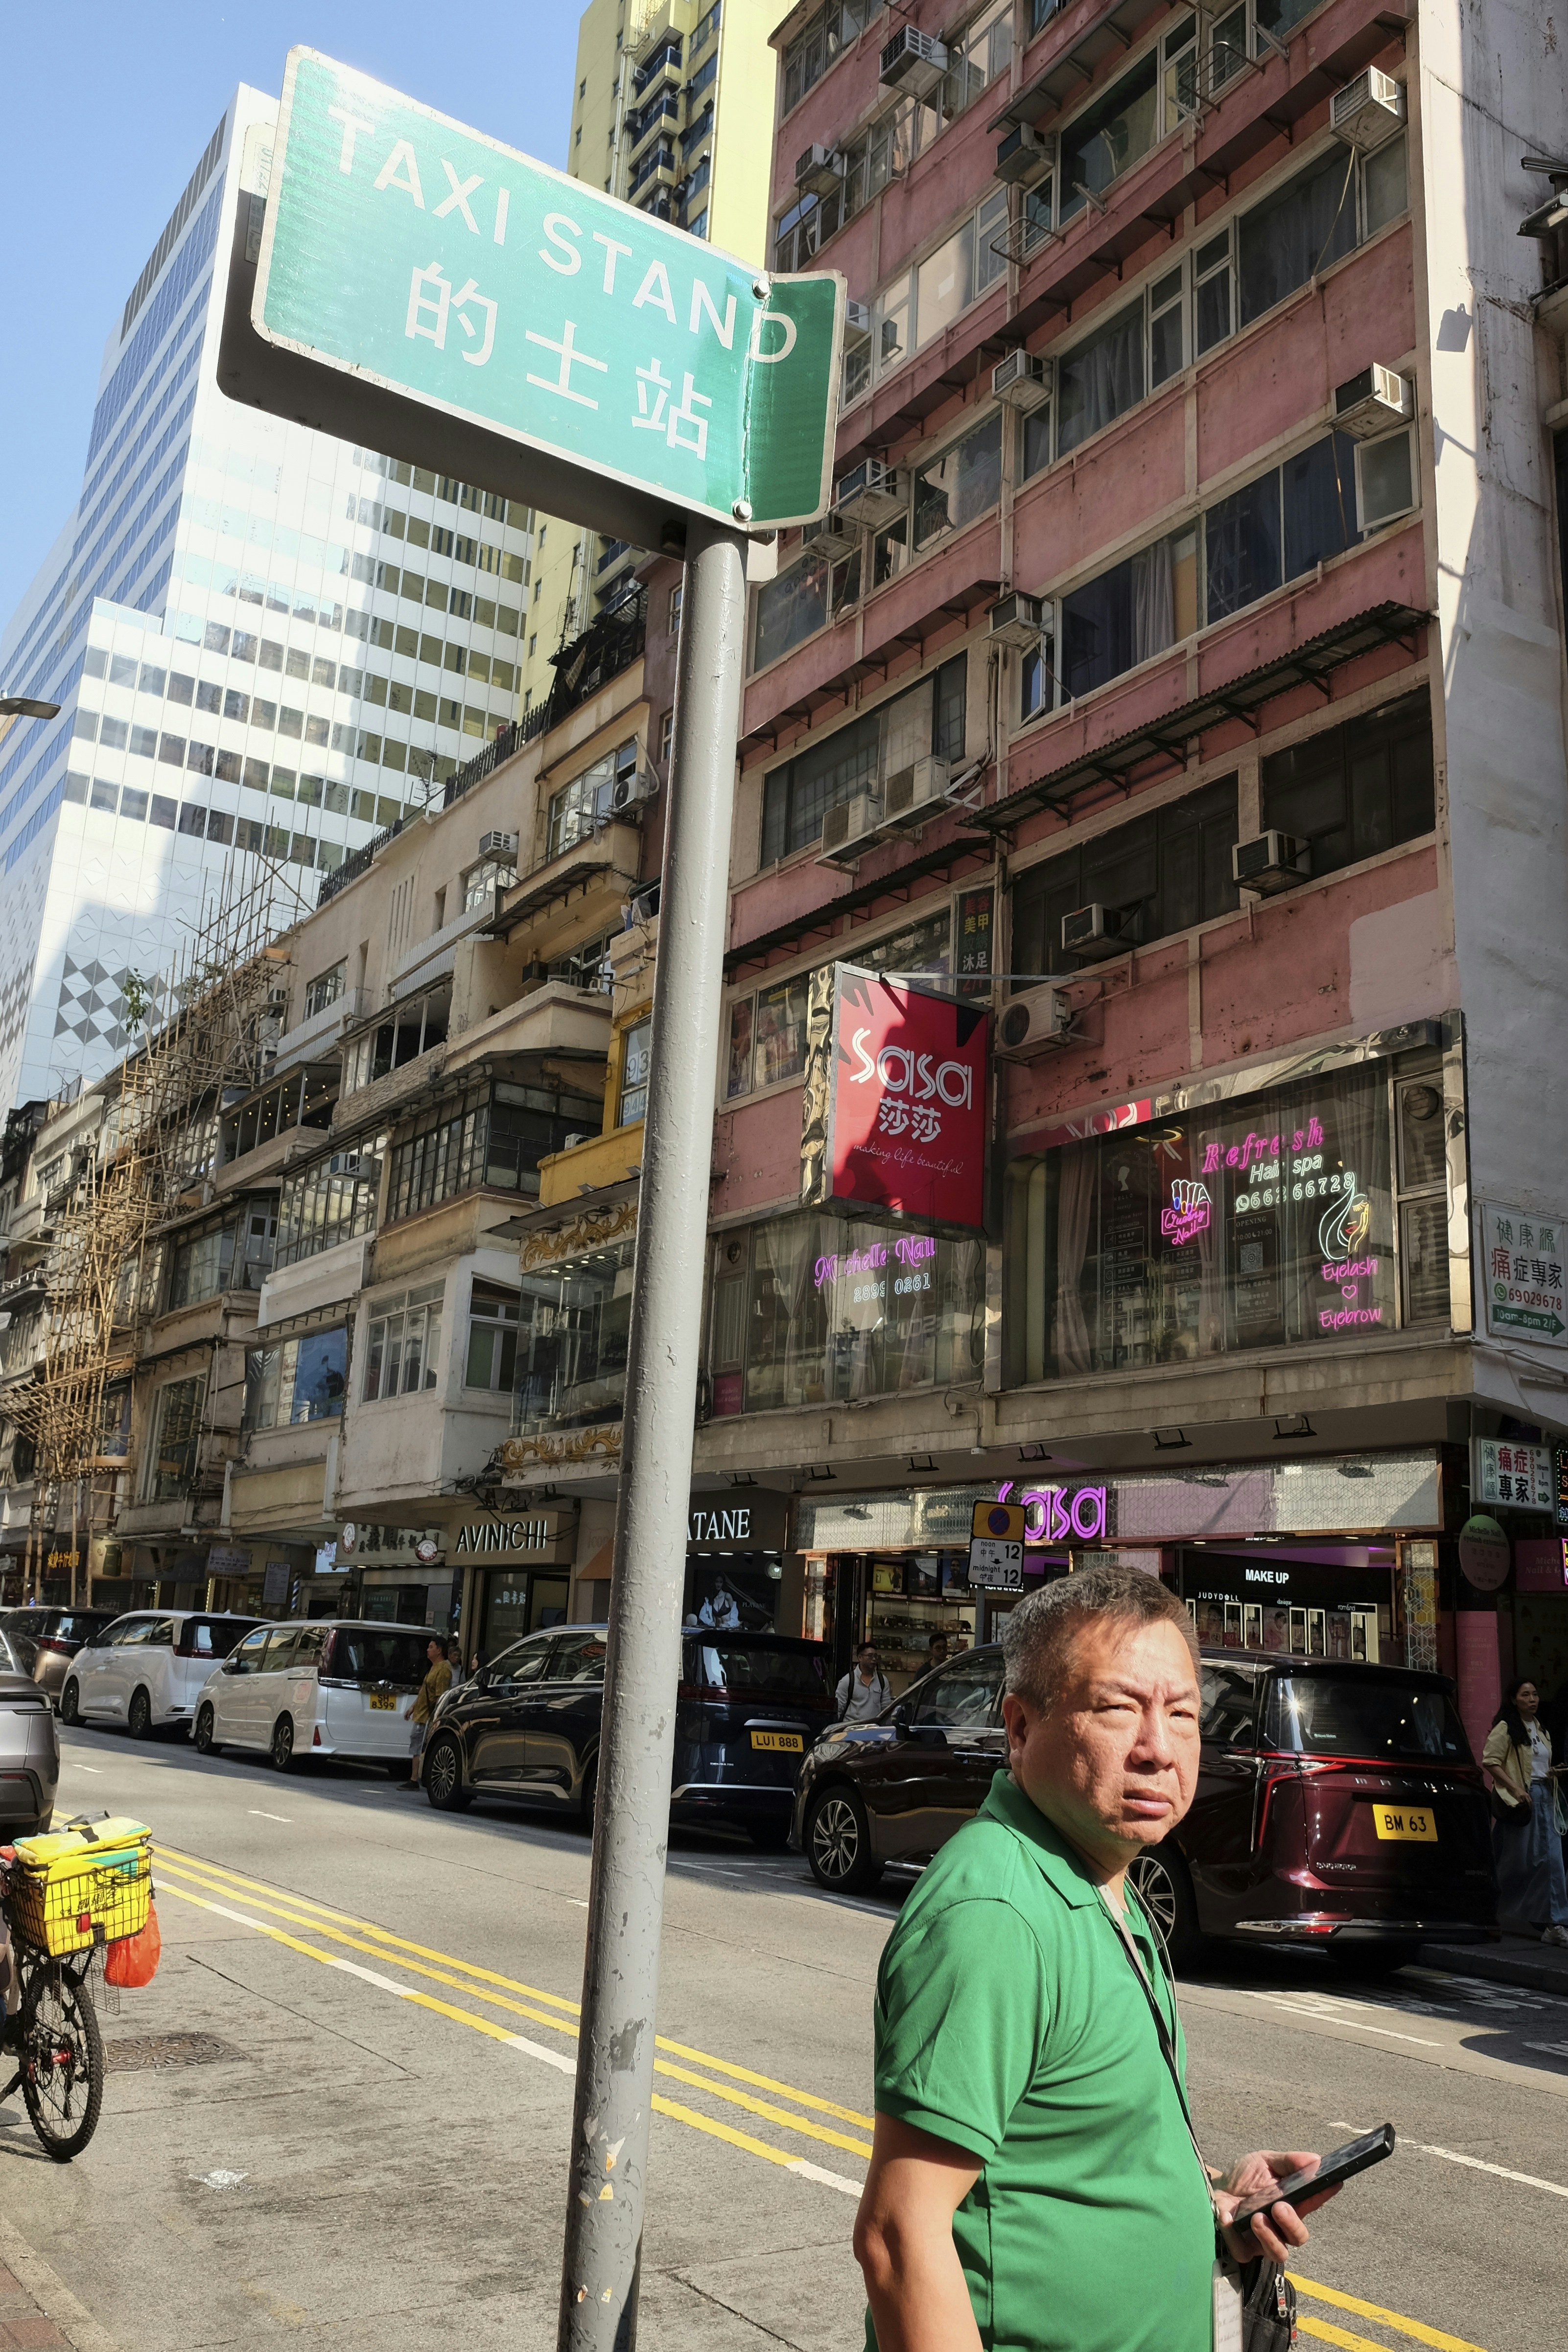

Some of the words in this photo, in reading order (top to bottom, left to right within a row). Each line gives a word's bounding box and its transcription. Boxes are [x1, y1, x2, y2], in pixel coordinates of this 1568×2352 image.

[328, 104, 510, 246] TAXI
[539, 212, 797, 365] STAND
[404, 261, 714, 462] 的士站
[964, 913, 988, 935] 美甲
[962, 951, 987, 972] 沐足
[879, 1096, 940, 1142] 莎莎
[1202, 1117, 1324, 1173] Refresh
[853, 1141, 891, 1164] making
[893, 1147, 914, 1168] life
[917, 1153, 964, 1178] beautiful
[1292, 1155, 1322, 1176] spa
[1172, 1220, 1199, 1245] Nail
[1236, 1216, 1267, 1228] OPENING
[1256, 1228, 1272, 1238] 21:00
[1496, 1216, 1556, 1253] 健康源
[815, 1243, 888, 1287] Mchelle
[895, 1235, 936, 1268] Nail
[1322, 1256, 1378, 1283] Eyelash
[1491, 1246, 1563, 1290] 痛症專家
[894, 1273, 930, 1295] 0261
[1508, 1288, 1562, 1310] 69029678
[1319, 1306, 1382, 1330] Eyebrow
[1543, 1317, 1557, 1330] 2/F
[1498, 1445, 1529, 1474] 痛症
[1498, 1474, 1530, 1503] 專家
[687, 1509, 750, 1540] TANE
[455, 1519, 547, 1554] AVINICHI
[981, 1548, 995, 1558] 中午
[1005, 1545, 1020, 1560] 12
[972, 1564, 1000, 1574] midnight
[1004, 1569, 1019, 1584] 12
[1245, 1569, 1274, 1583] MAKE
[1275, 1571, 1289, 1584] UP
[372, 1701, 395, 1710] 8399
[377, 1694, 389, 1702] SH
[778, 1737, 798, 1748] 888
[1384, 1814, 1404, 1831] BM
[1409, 1816, 1427, 1832] 63
